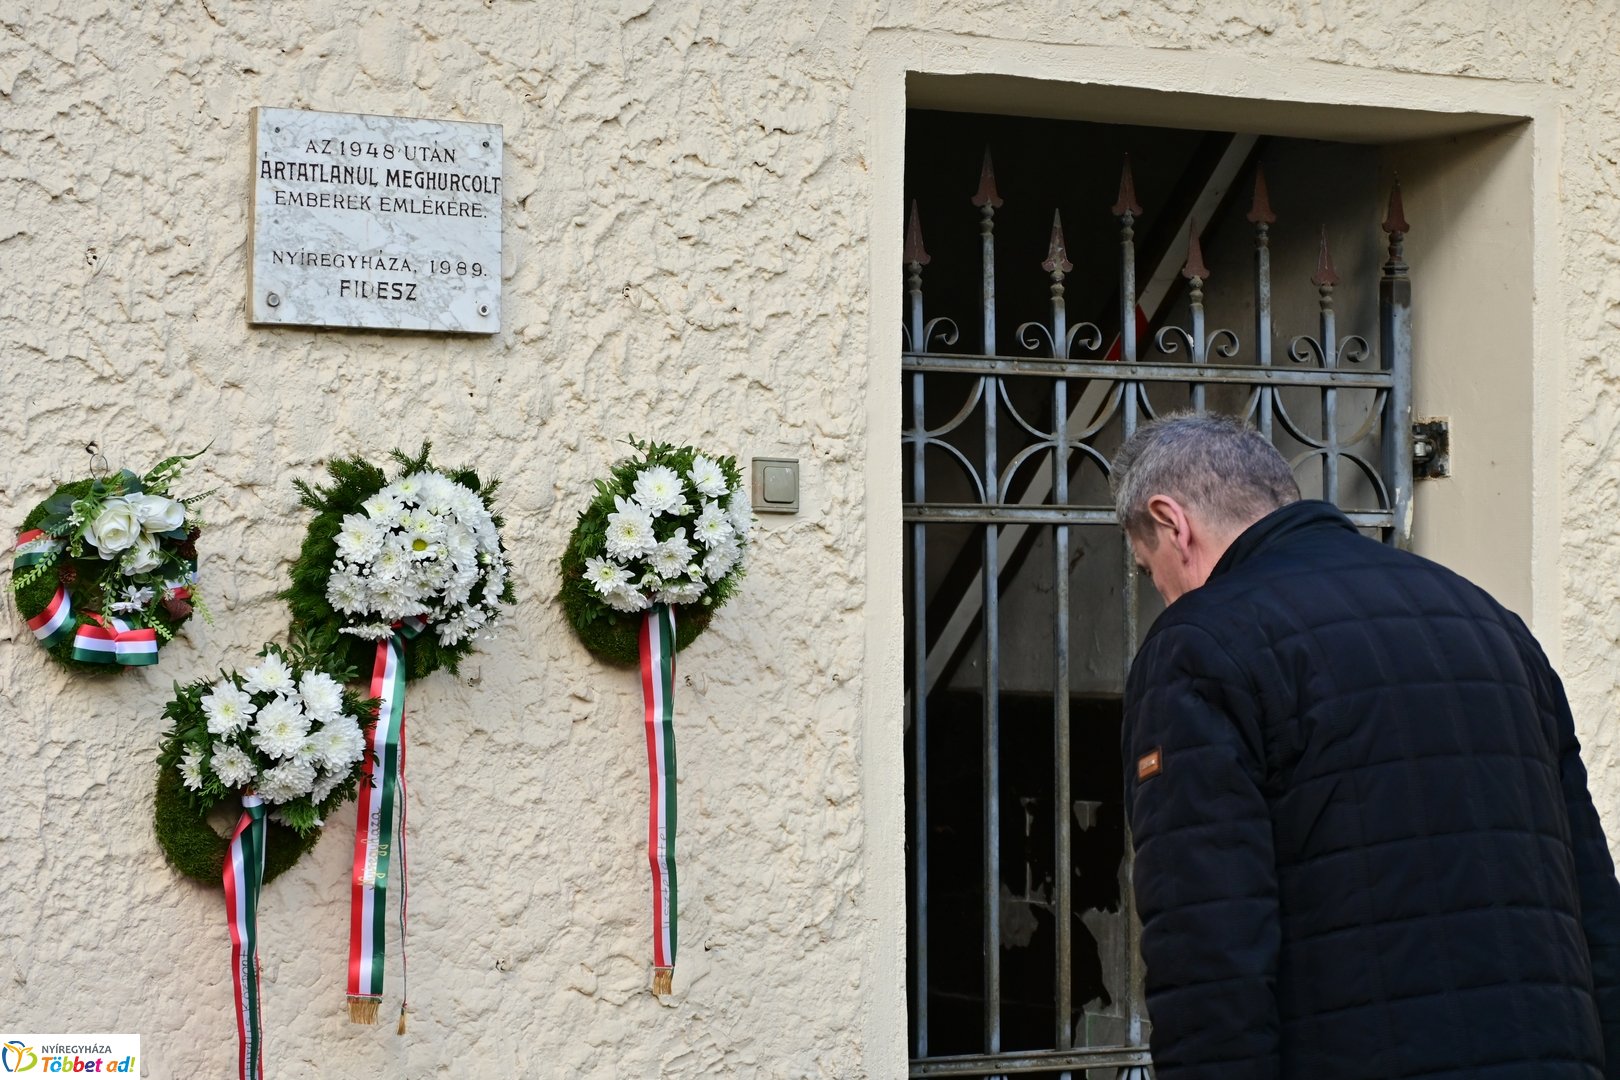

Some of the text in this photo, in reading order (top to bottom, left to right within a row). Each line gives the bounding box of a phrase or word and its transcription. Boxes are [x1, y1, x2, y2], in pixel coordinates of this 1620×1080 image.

[305, 139, 456, 164] AZ 1948 UTÁN
[385, 168, 501, 195] MEGHURCOLT
[274, 190, 488, 219] EMBEREK EMLÉKÉRE.
[272, 247, 488, 277] NYÍREGYHÁZA, 1989.
[339, 279, 417, 301] FIDESZ
